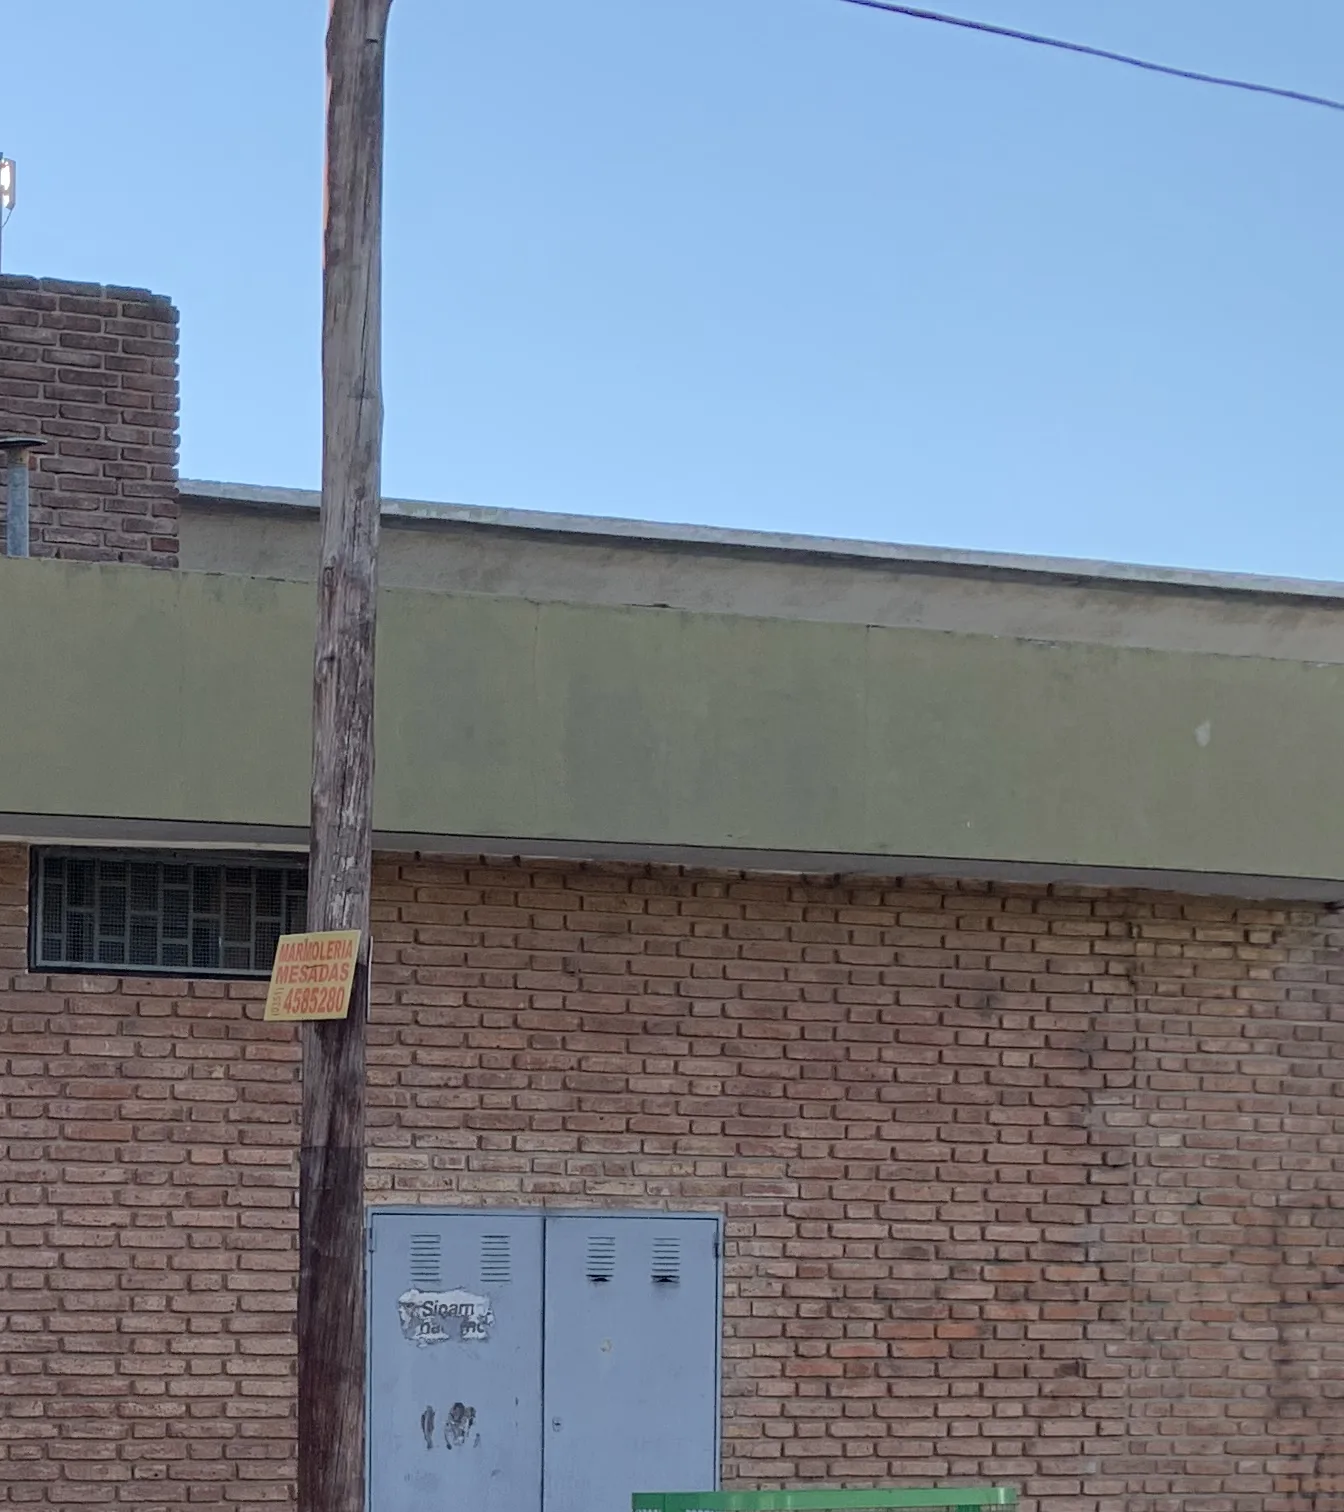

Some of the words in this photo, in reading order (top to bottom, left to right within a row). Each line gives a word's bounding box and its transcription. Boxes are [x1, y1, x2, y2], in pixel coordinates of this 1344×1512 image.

[279, 940, 354, 962] MARMOLERIA
[275, 962, 350, 985] MESADAS
[283, 986, 346, 1015] 4585280
